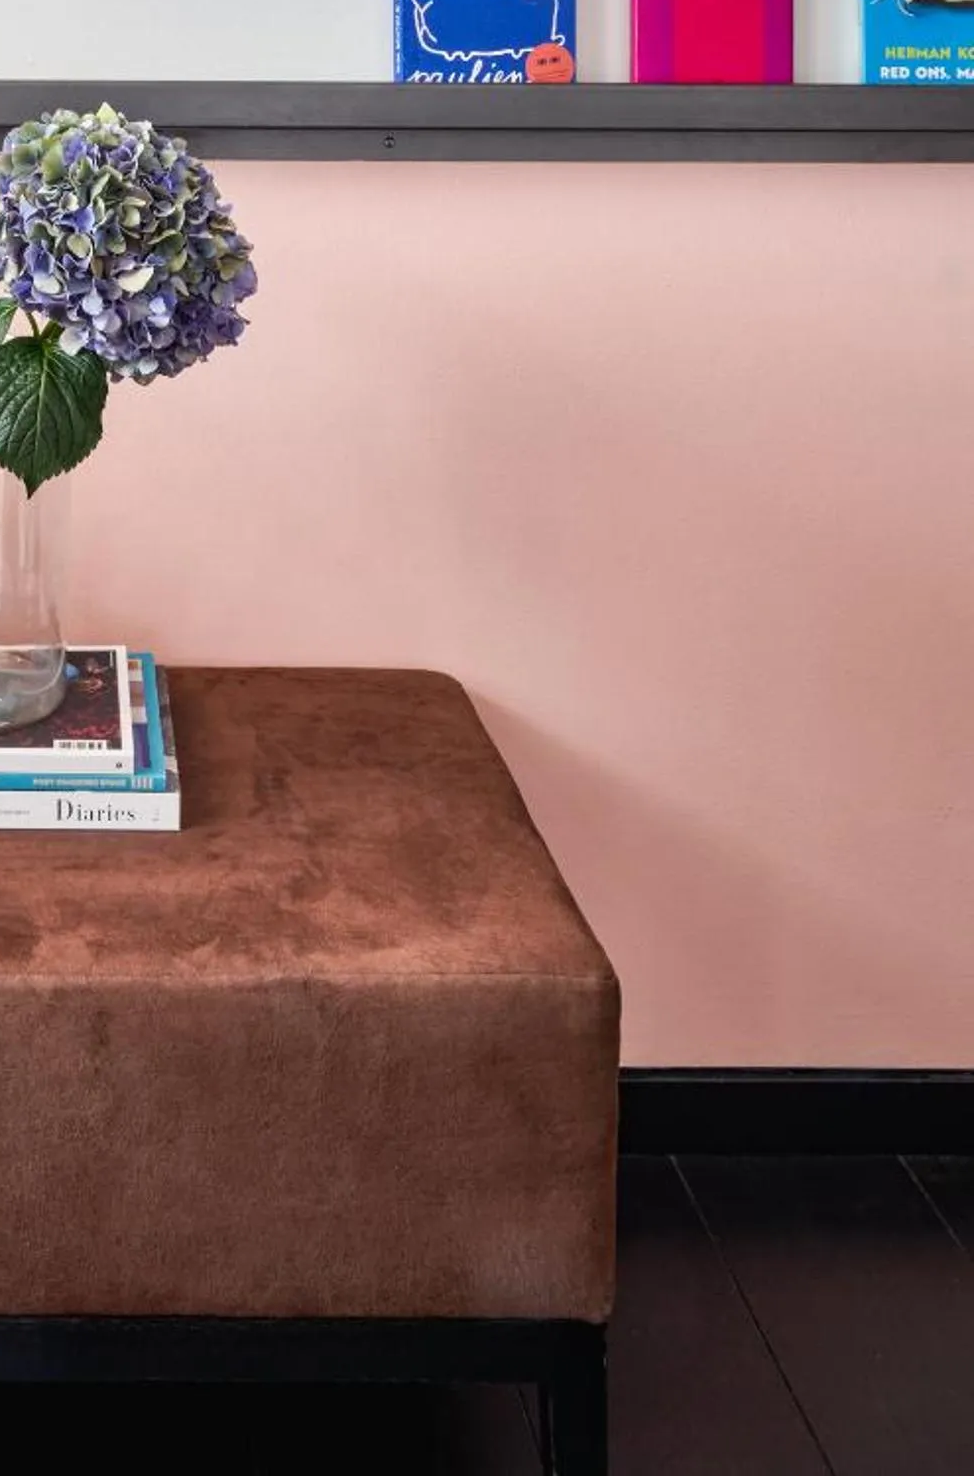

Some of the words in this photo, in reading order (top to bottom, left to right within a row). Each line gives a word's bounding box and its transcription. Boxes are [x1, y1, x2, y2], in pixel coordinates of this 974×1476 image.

[885, 47, 951, 60] HERMAN
[880, 66, 910, 80] RED
[915, 66, 951, 80] ONS.
[56, 798, 137, 823] Diaries
